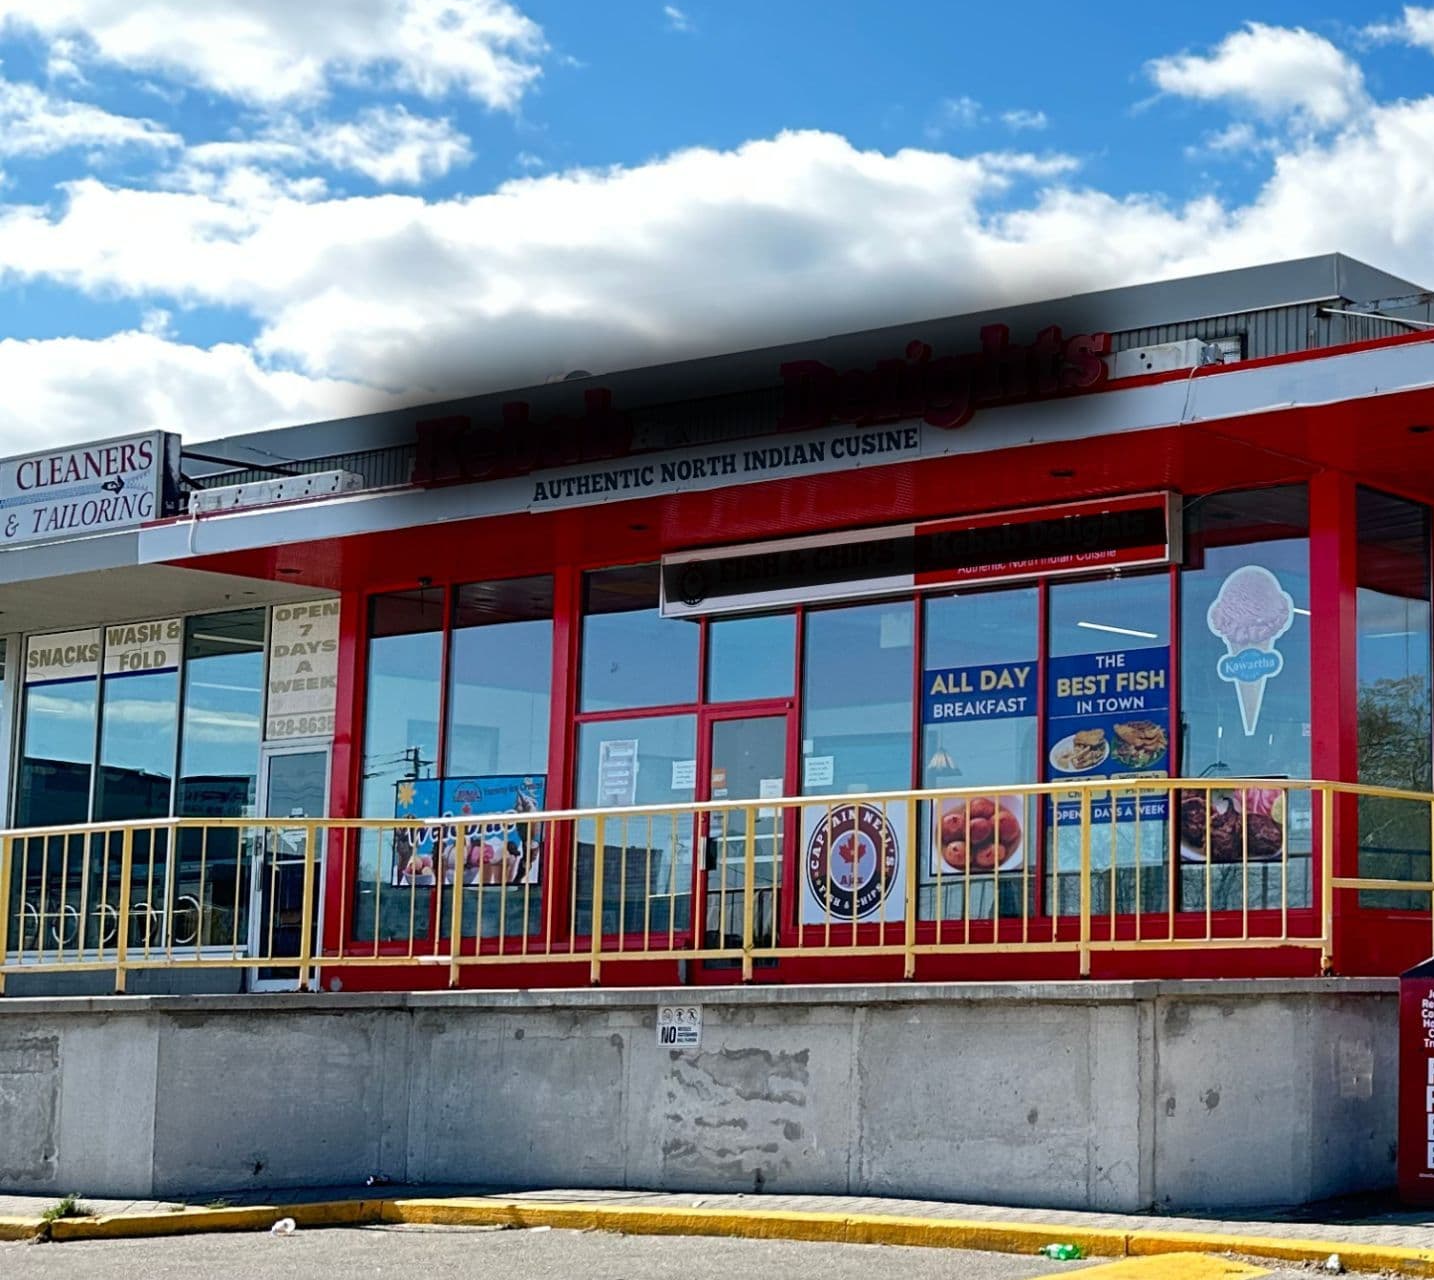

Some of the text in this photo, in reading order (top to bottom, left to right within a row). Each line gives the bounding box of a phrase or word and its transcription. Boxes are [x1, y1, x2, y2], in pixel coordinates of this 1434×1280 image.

[16, 440, 153, 491] CLEANERS
[533, 427, 919, 502] AUTHENTIC NORTH INDIAN CUSINE
[5, 491, 154, 537] & TAILORING
[275, 602, 339, 621] OPEN
[107, 621, 180, 647] WASH &
[299, 624, 313, 636] 7
[28, 643, 99, 668] SNACKS
[274, 639, 337, 658] DAYS
[119, 650, 167, 670] FOLD
[295, 661, 313, 674] A
[1096, 654, 1125, 668] THE
[270, 675, 337, 694] WEEK
[930, 666, 1031, 696] ALL DAY
[1057, 669, 1166, 698] BEST FISH
[933, 697, 1027, 718] BREAKFAST
[1077, 696, 1145, 714] IN TOWN
[1056, 809, 1082, 821] OPEN
[1094, 806, 1122, 819] DAS
[1124, 806, 1133, 816] A
[404, 810, 517, 847] Welome
[661, 1026, 677, 1044] NO
